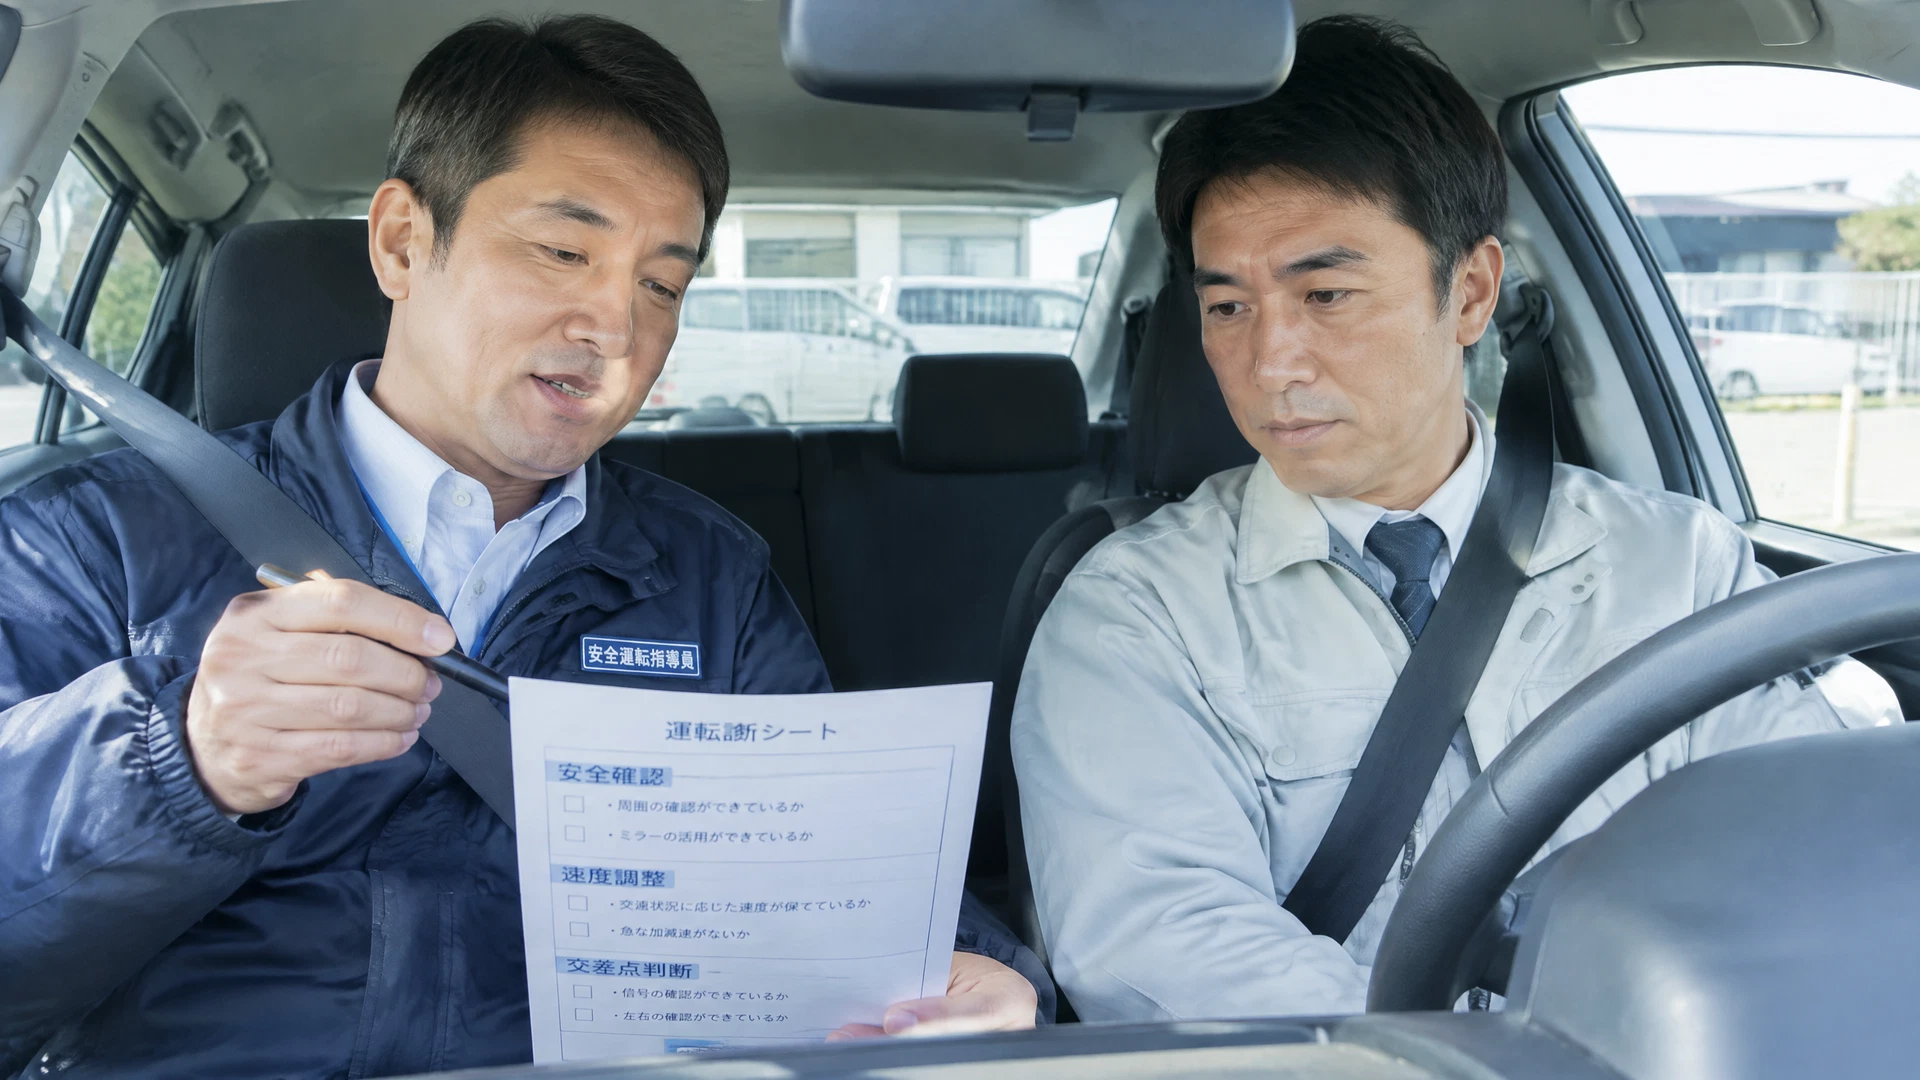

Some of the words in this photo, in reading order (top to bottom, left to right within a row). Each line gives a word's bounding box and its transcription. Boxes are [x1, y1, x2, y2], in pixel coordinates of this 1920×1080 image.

[587, 643, 695, 671] 安全運転指導員
[557, 762, 665, 787] 安全確認
[561, 866, 666, 888] 速度調整
[566, 957, 693, 979] 交差点判断
